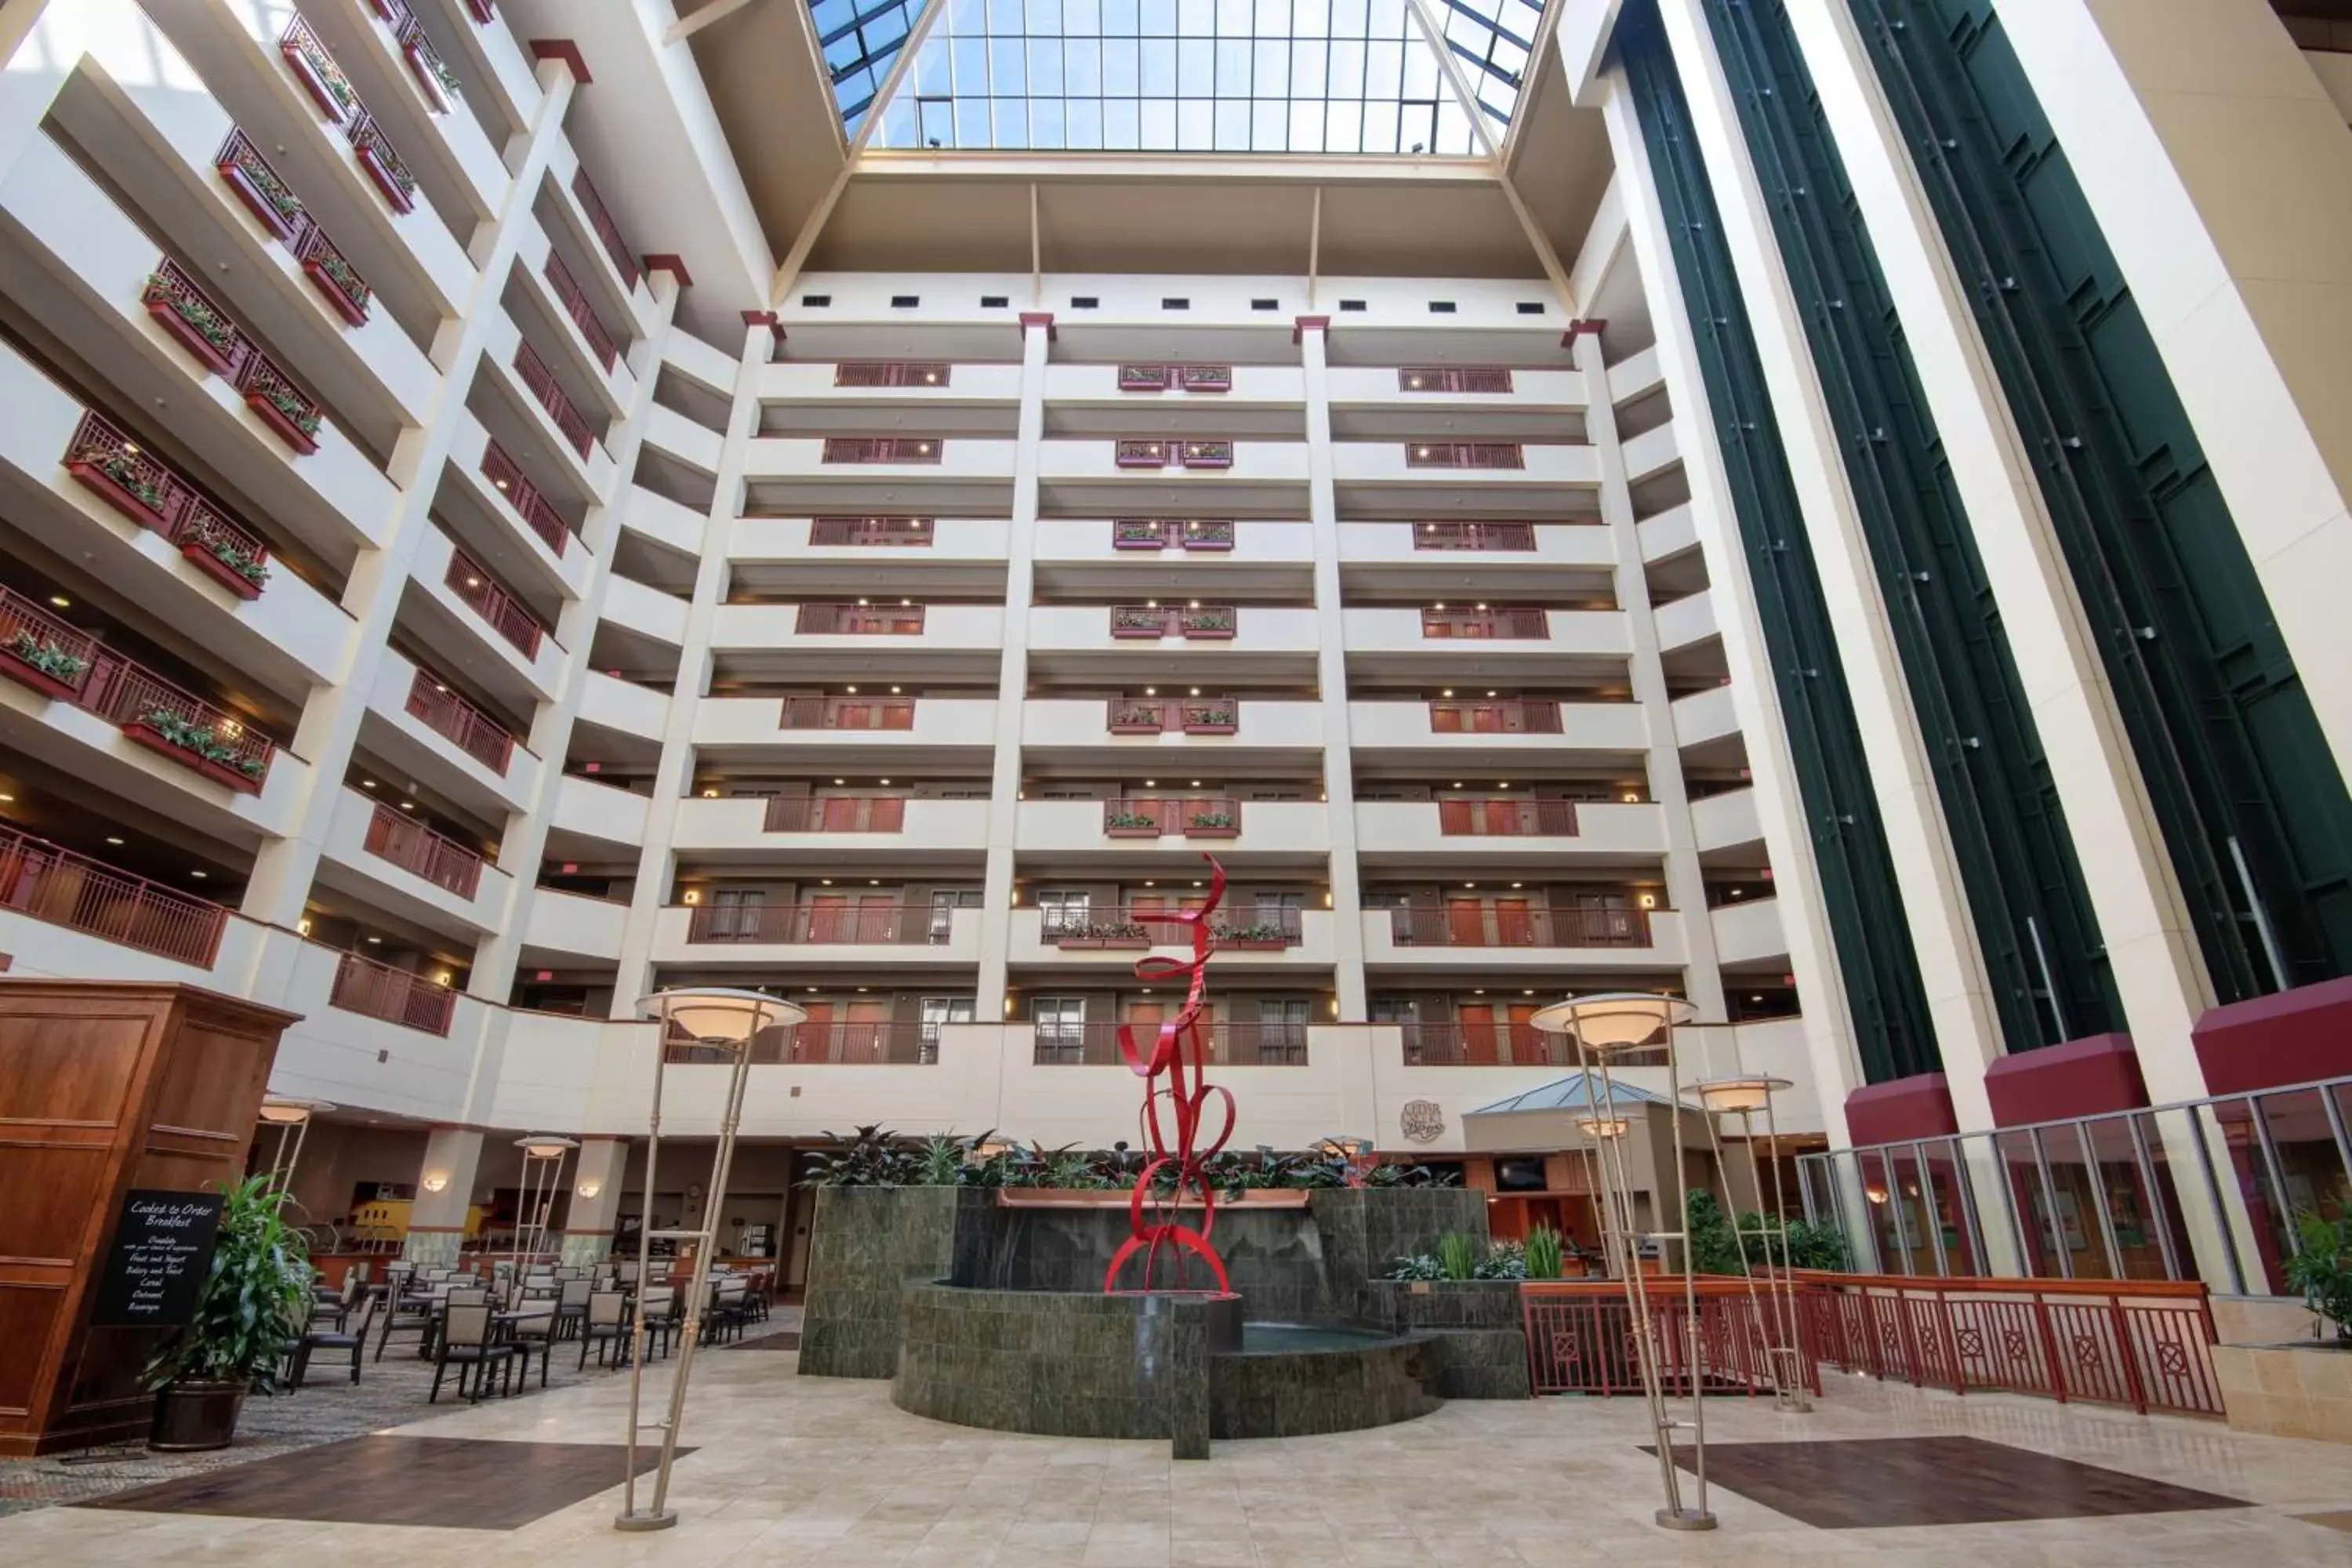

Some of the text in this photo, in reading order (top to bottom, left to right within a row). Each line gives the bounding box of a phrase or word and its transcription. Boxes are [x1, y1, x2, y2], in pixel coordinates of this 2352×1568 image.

[131, 1200, 213, 1216] Cooked to Order
[145, 1214, 193, 1228] Breakfast
